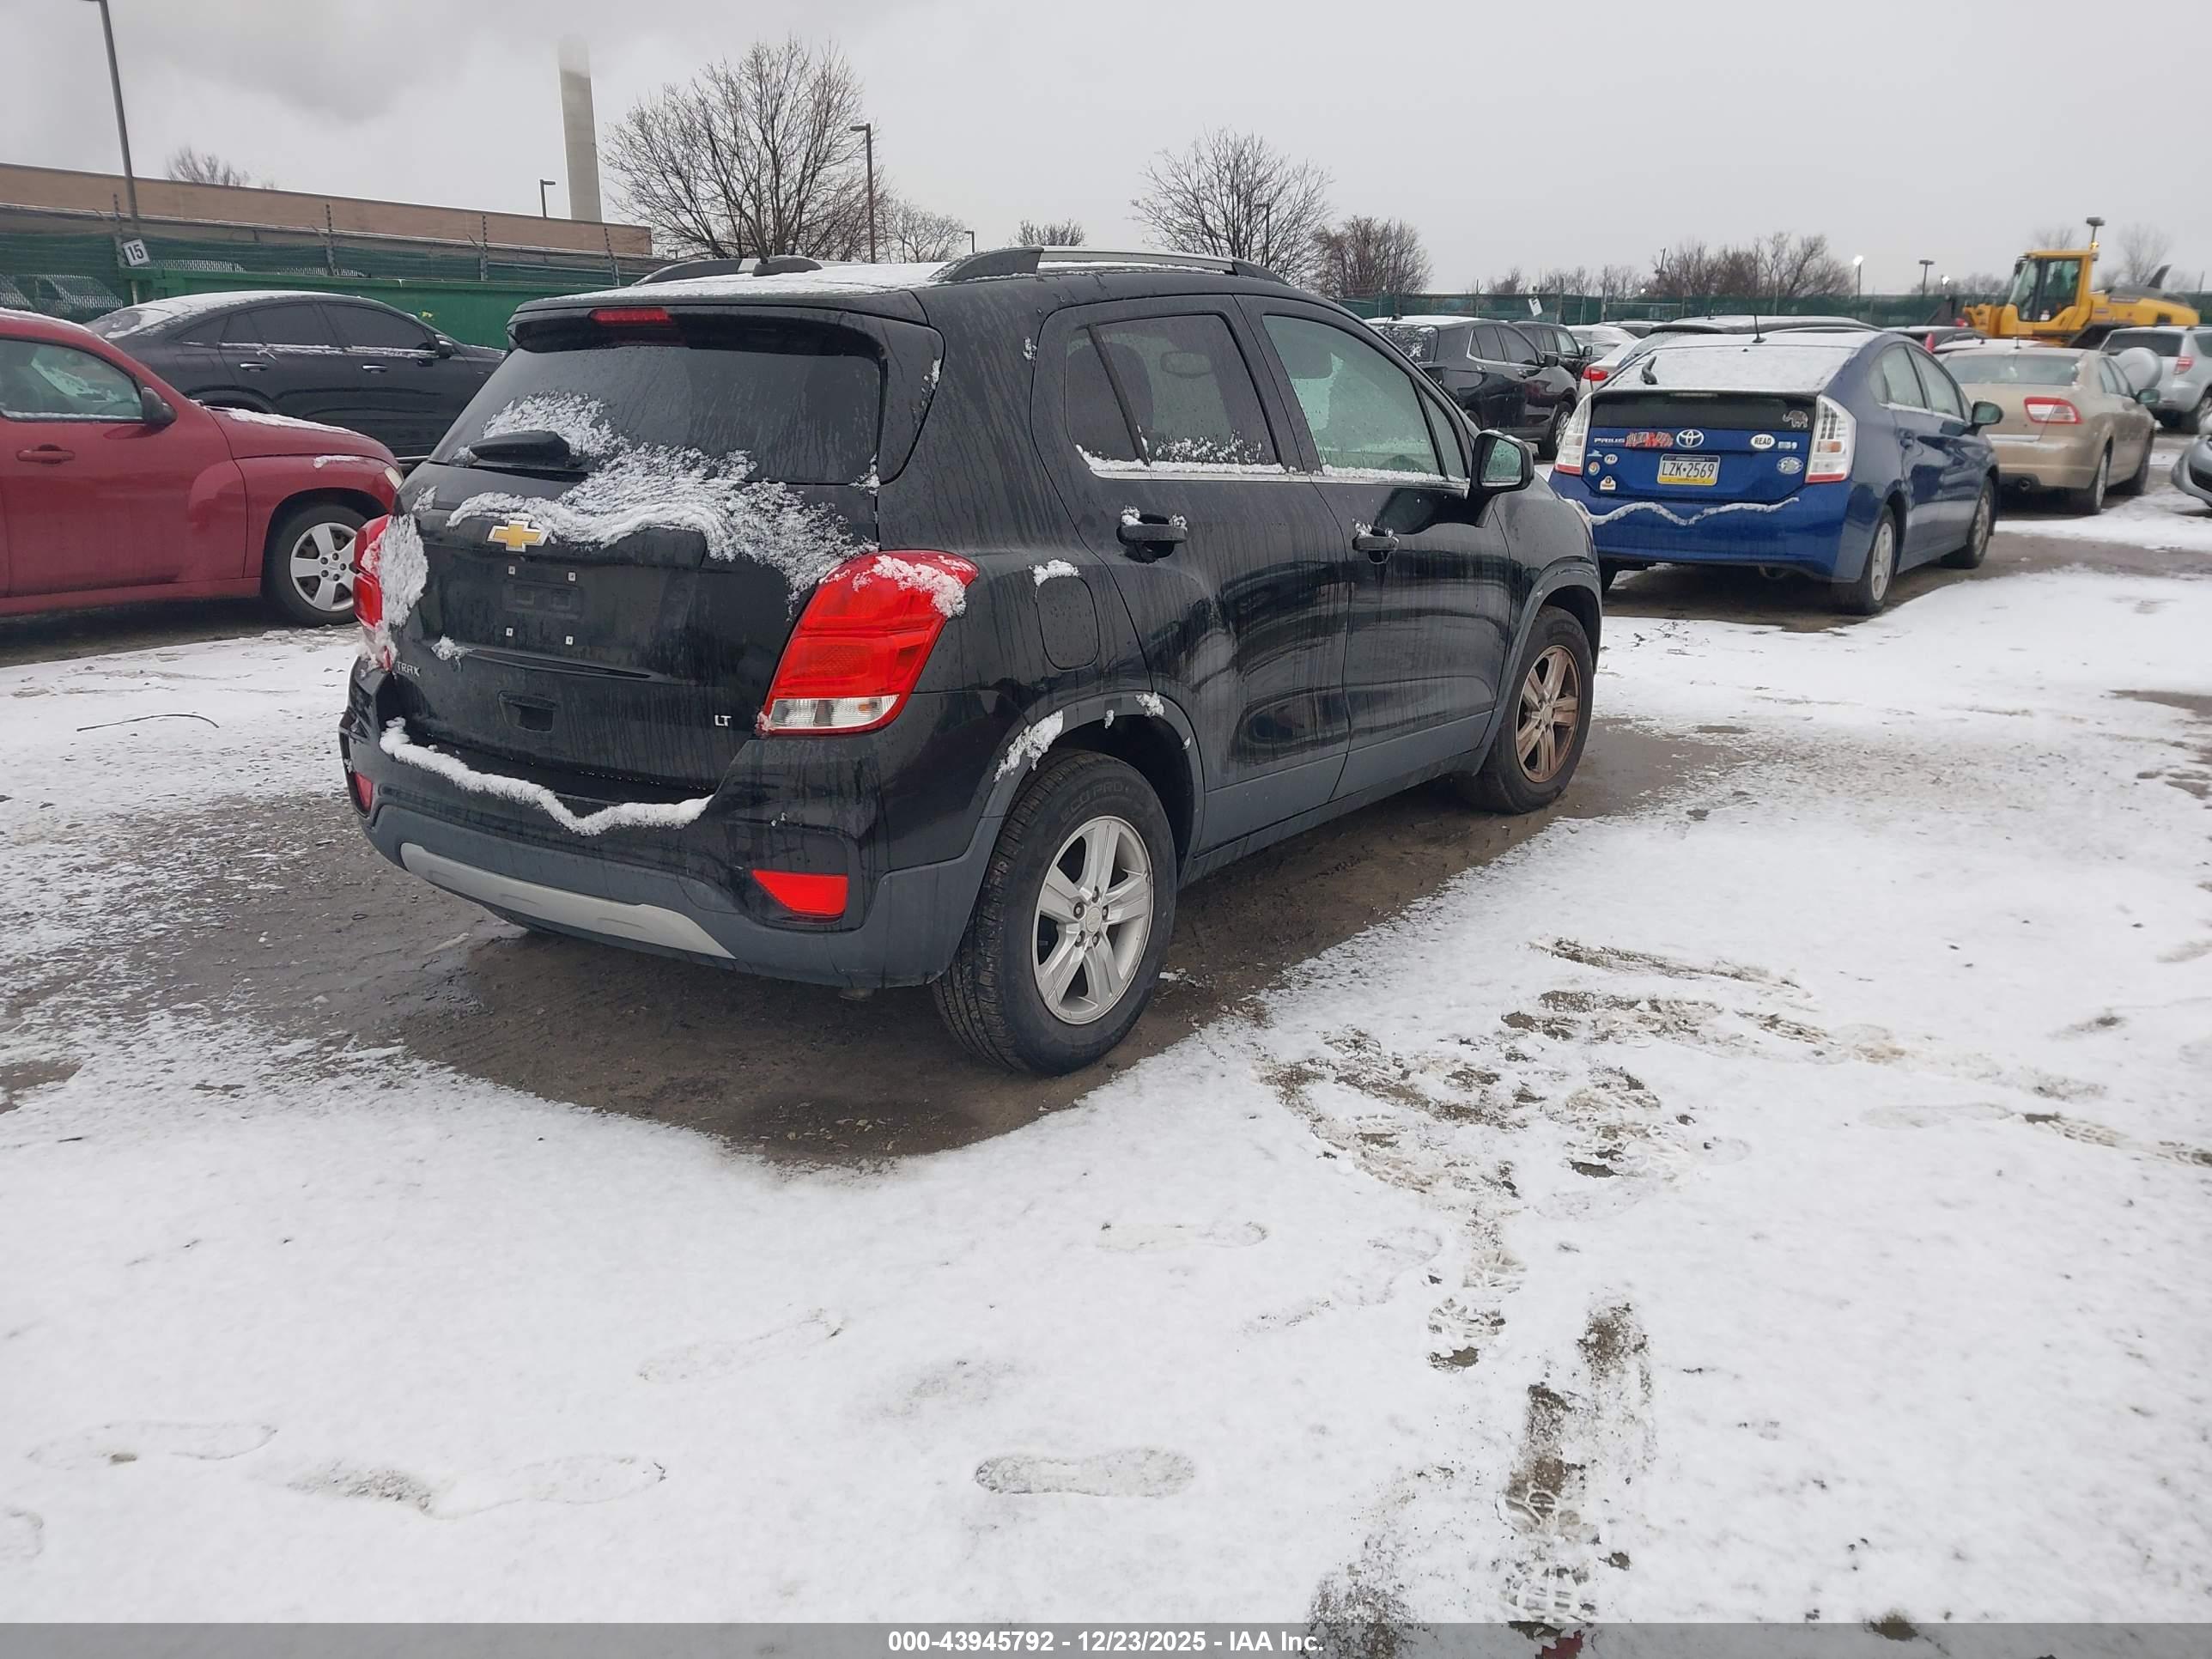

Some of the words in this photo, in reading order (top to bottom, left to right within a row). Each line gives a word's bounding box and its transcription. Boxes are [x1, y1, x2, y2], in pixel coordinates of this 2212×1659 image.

[127, 244, 144, 260] 15
[397, 660, 420, 678] TRAX
[714, 714, 732, 726] LT
